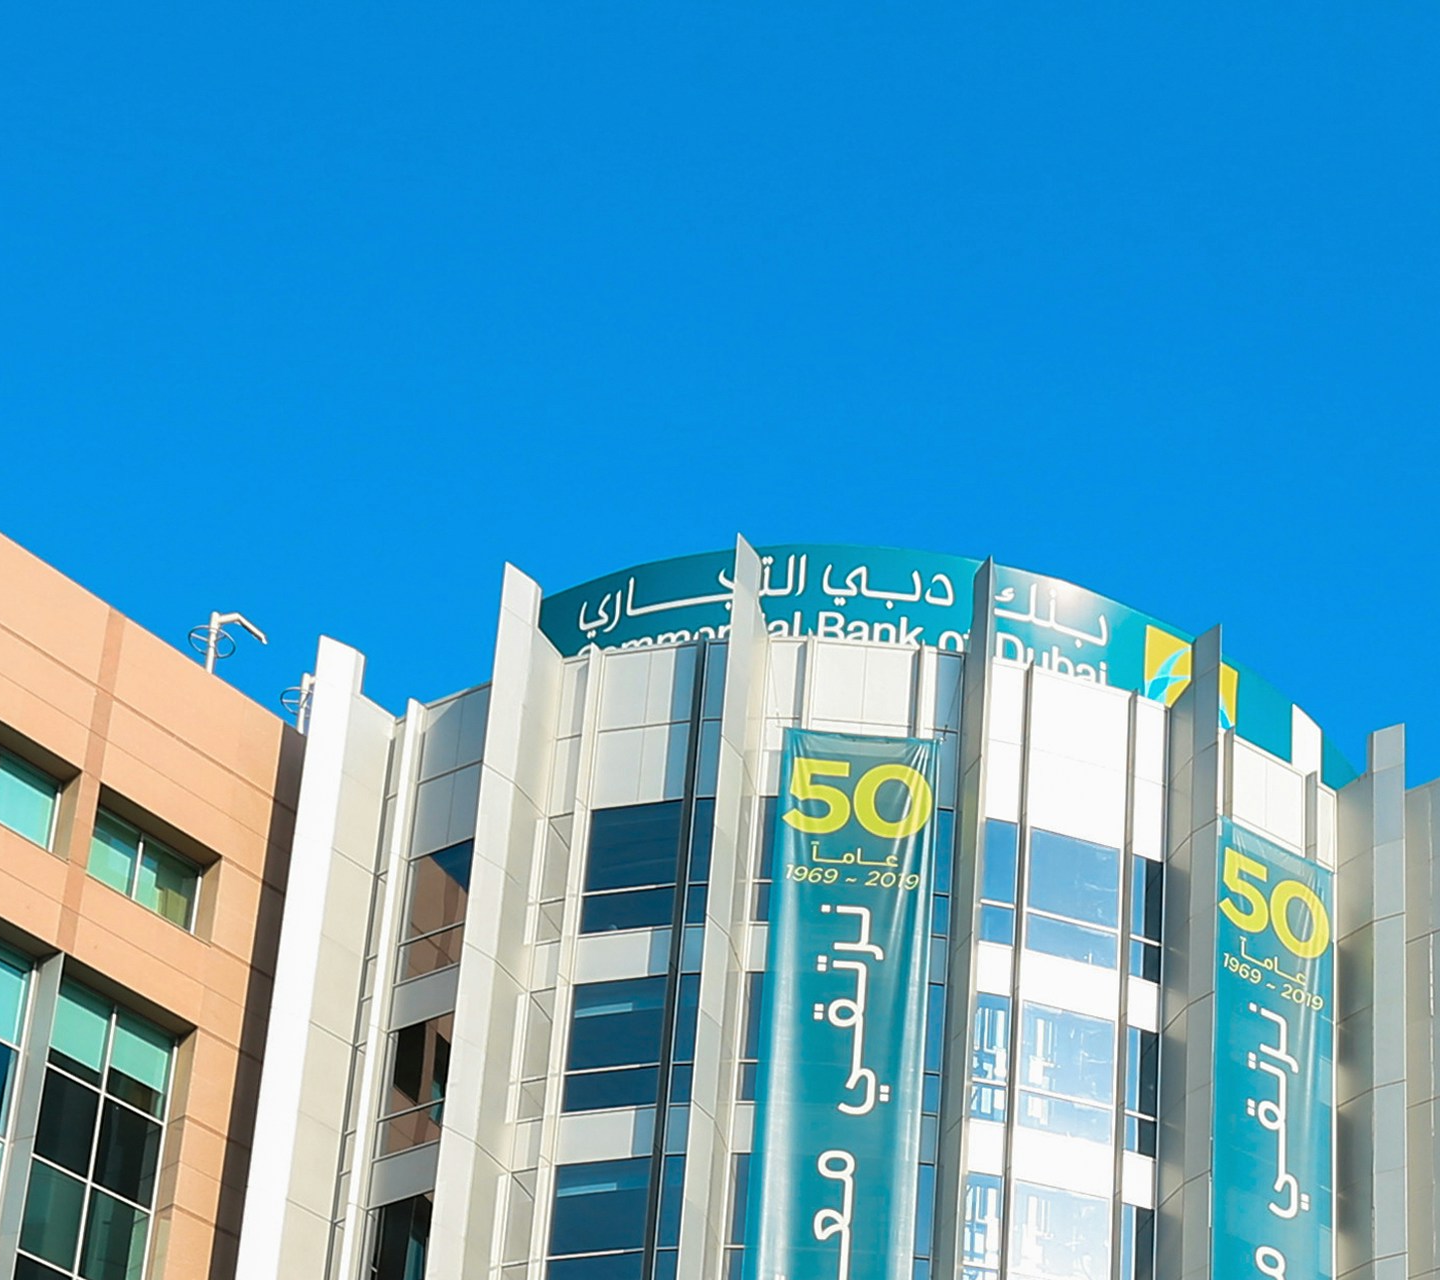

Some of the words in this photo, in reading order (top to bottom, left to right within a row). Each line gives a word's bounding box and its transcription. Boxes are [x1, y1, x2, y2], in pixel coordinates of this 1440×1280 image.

[822, 563, 954, 609] دبي
[994, 582, 1108, 648] بنك
[817, 611, 923, 648] Bank
[938, 628, 971, 653] o
[782, 757, 932, 838] 50
[785, 864, 838, 885] 1969
[864, 869, 919, 890] 2019
[1218, 846, 1330, 959] 50
[812, 903, 891, 1115] نرتقي
[1223, 952, 1262, 985] 1969
[1280, 979, 1324, 1012] 2019
[1248, 1002, 1309, 1219] نرتقي
